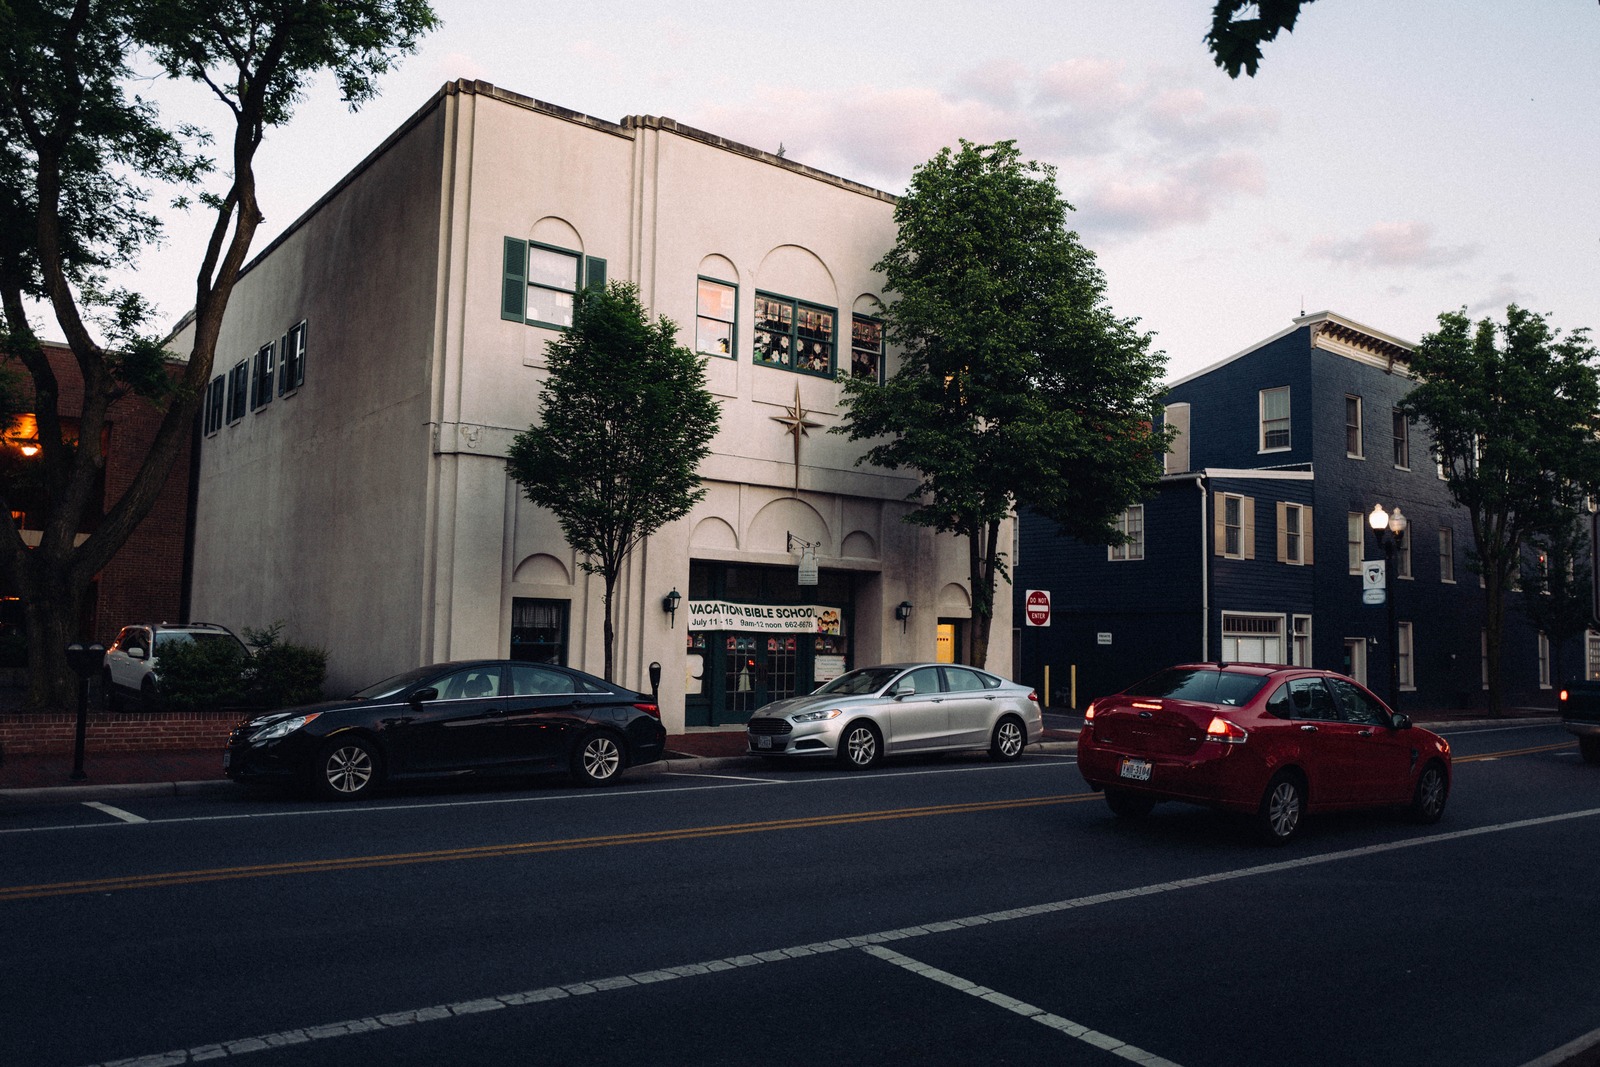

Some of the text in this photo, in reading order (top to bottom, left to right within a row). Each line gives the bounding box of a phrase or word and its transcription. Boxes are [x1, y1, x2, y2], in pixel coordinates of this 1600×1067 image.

[690, 603, 817, 618] VACATION BIBLE SCHOOL
[692, 618, 707, 627] July
[740, 619, 764, 627] 9am-12
